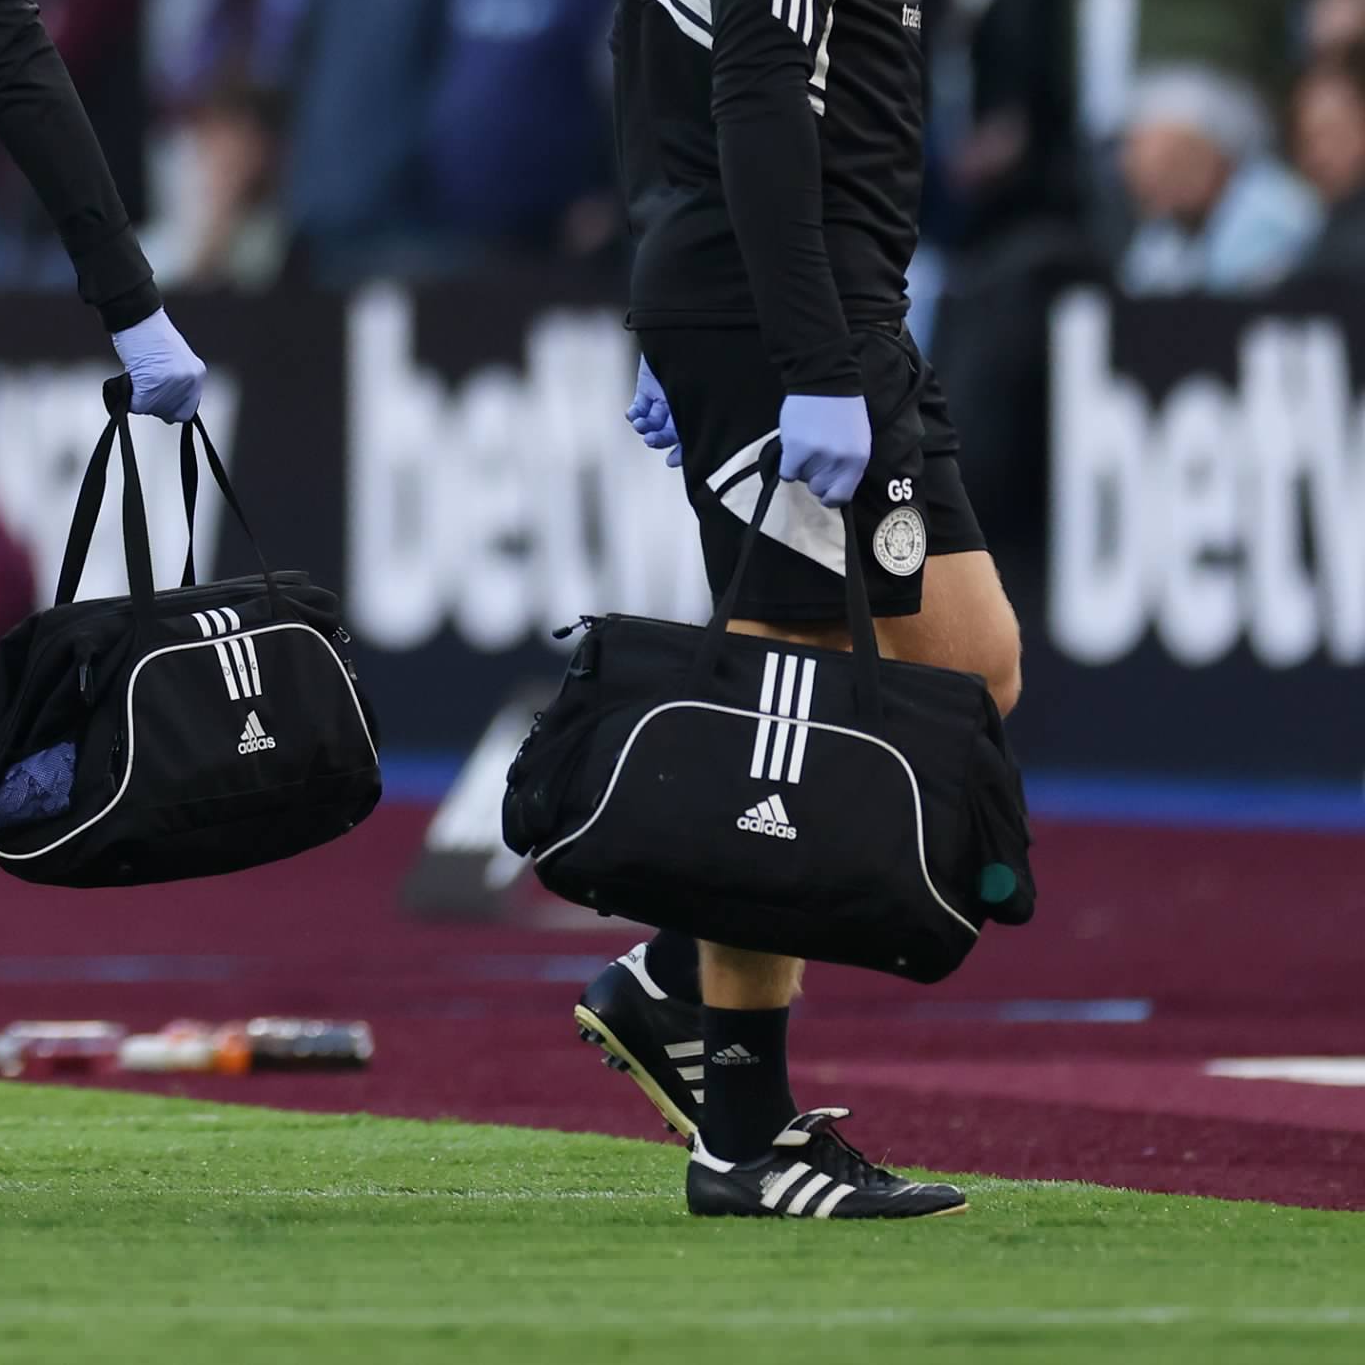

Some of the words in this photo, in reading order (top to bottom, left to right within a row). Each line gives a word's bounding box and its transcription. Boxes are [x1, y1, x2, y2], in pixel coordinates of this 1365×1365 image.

[888, 477, 914, 502] GS
[237, 736, 276, 755] addas
[736, 816, 797, 840] adidas
